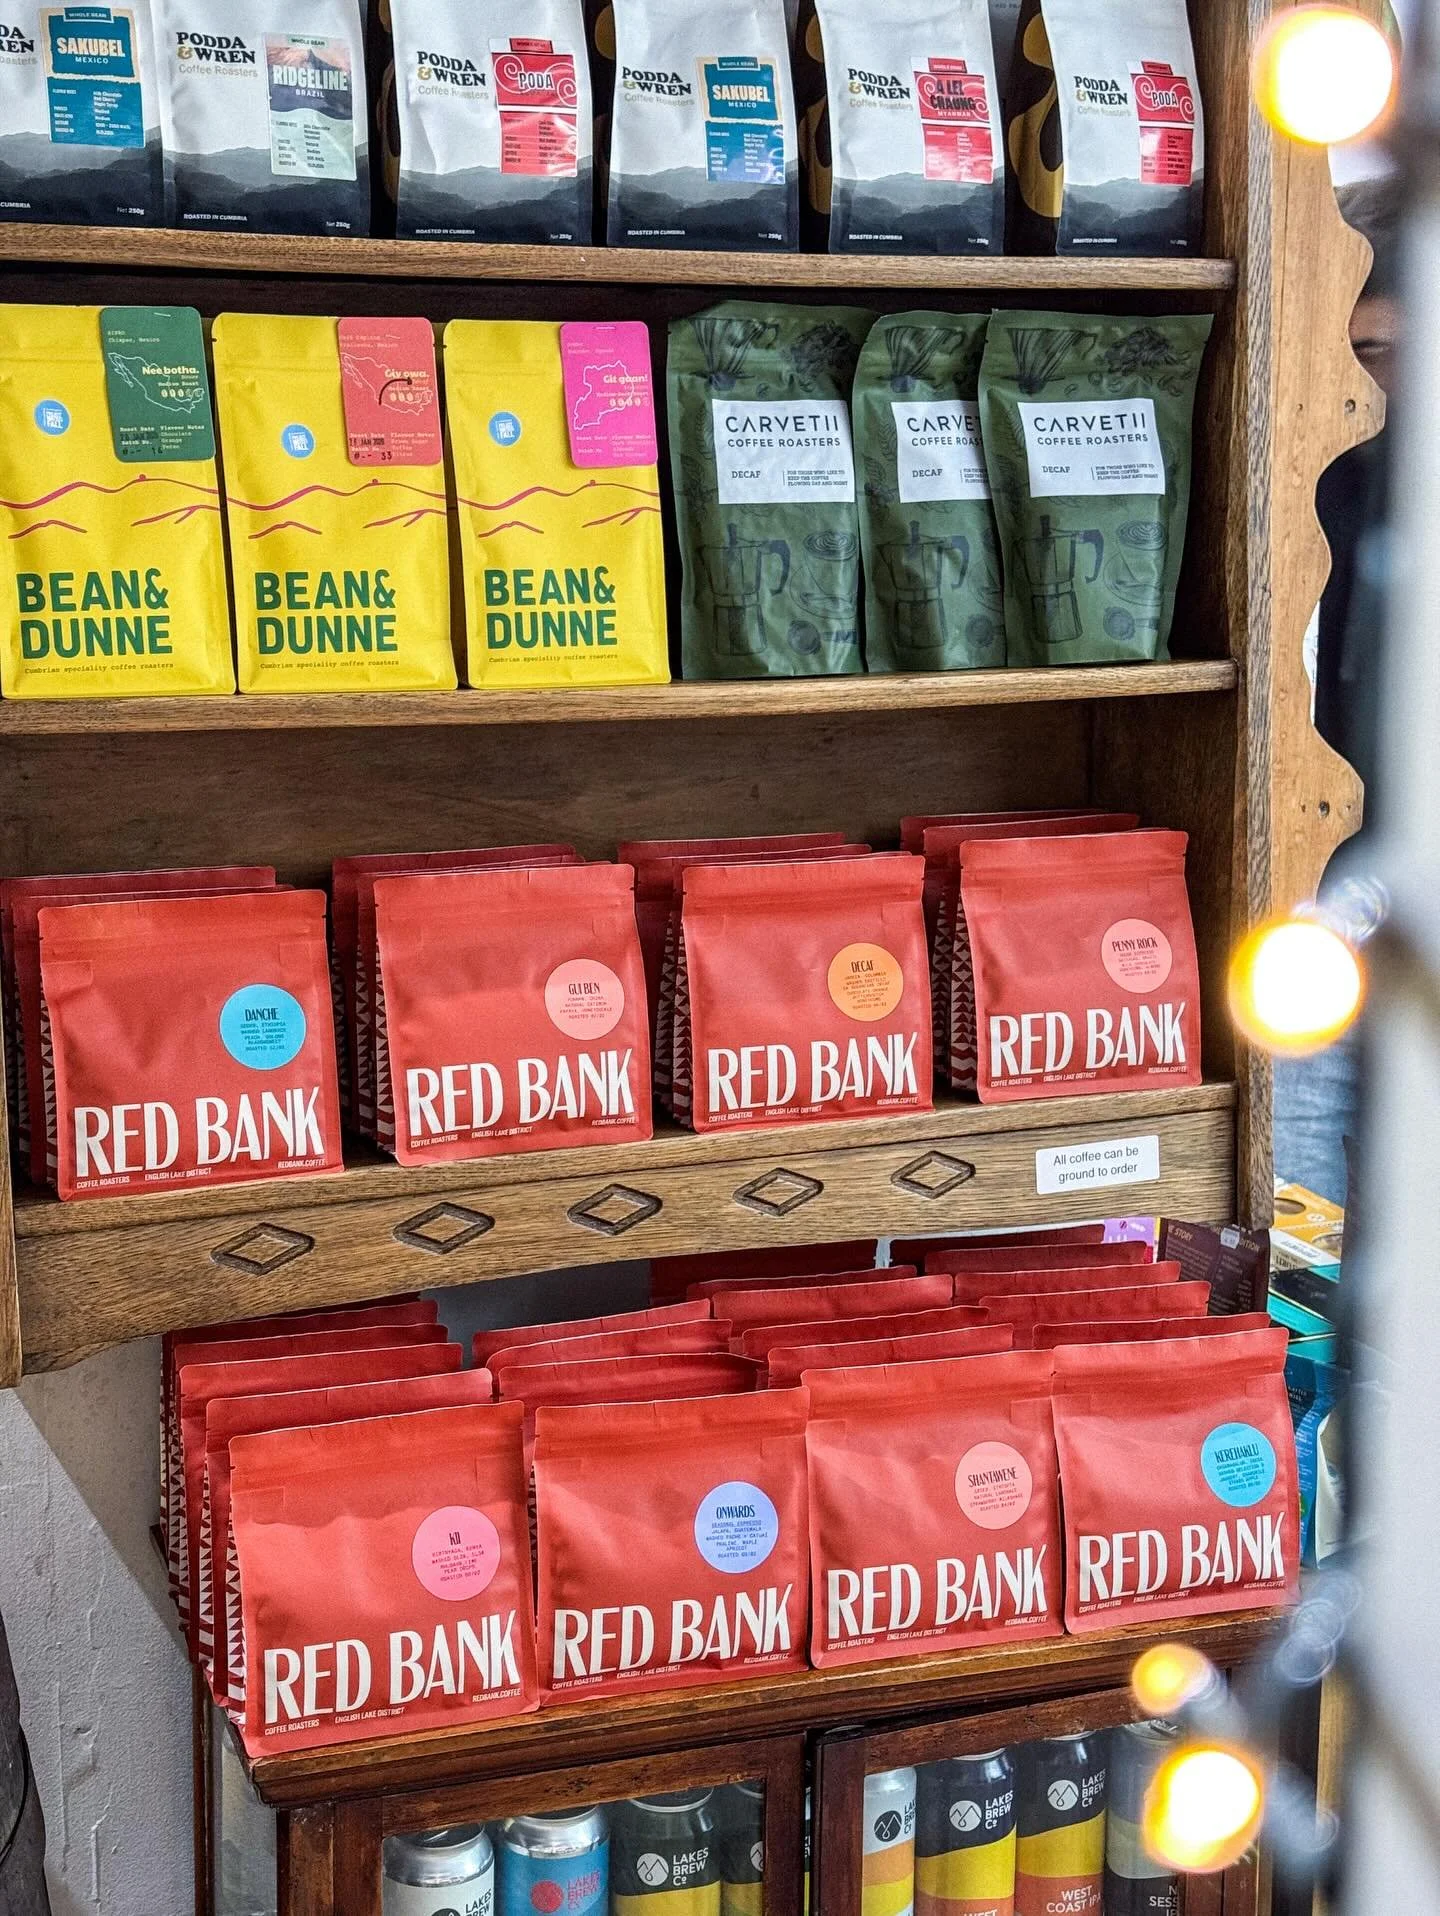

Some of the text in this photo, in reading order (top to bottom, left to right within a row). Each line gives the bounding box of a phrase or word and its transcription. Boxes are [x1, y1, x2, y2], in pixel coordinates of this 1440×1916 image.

[57, 37, 125, 57] SAKUBEL
[176, 31, 247, 50] PODDA
[75, 56, 108, 64] MEXICO
[417, 51, 477, 72] PODDA
[179, 64, 258, 78] Coffee Roasters
[272, 65, 348, 91] RIDGELINE
[622, 66, 683, 83] PODDA
[848, 68, 902, 87] PODDA
[519, 72, 555, 90] PODA
[937, 80, 945, 93] A
[1074, 76, 1120, 92] PODDA
[295, 89, 325, 98] BRAZIL
[418, 85, 449, 96] Coffee
[712, 85, 770, 102] SAKUBEL
[930, 95, 976, 111] CHAUNG
[1152, 91, 1179, 108] PODA
[938, 110, 971, 118] MYANMAR
[129, 207, 145, 216] 250g
[603, 375, 617, 383] Git
[725, 415, 839, 433] CARVETII
[1034, 413, 1145, 432] CARVETII
[728, 438, 840, 448] COFFEE ROASTERS
[912, 436, 953, 446] COFFEE
[1037, 434, 1148, 445] COFFEE ROASTERS
[732, 471, 761, 479] DECAF
[912, 469, 943, 478] DECAF
[16, 568, 168, 613] BEAN&
[255, 568, 396, 610] BEAN&
[484, 566, 615, 606] BEAN&
[20, 615, 173, 660] DUNNE
[257, 614, 398, 655] DUNNE
[486, 610, 618, 650] DUNNE
[24, 662, 174, 675] Cumbrian speciality coffee roasters
[296, 662, 337, 670] speciality
[523, 656, 561, 664] speciality
[1112, 937, 1158, 952] PENNY ROCK
[851, 960, 874, 973] DECAF
[569, 982, 600, 995] GUI BEN
[245, 1008, 280, 1021] DANCHE
[990, 1002, 1186, 1077] RED BANK
[708, 1032, 918, 1113] RED BANK
[406, 1048, 635, 1137] RED BANK
[74, 1086, 325, 1177] RED BANK
[411, 1126, 533, 1148] COFFEE ROASTERS ENGLISH LAKE DISTRICT
[1053, 1146, 1139, 1166] All coffee can be
[76, 1168, 212, 1189] COFFEE ROASTERS ENGLISH LAKE DISTRICT
[1058, 1162, 1138, 1184] ground to order
[968, 1466, 1019, 1488] SHANTAWENE
[716, 1505, 755, 1519] ONWARDS
[1079, 1512, 1285, 1602] RED BANK
[827, 1544, 1048, 1639] RED BANK
[553, 1583, 793, 1680] RED BANK
[827, 1627, 947, 1650] COFFEE ROASTERS ENGLISH LAKE DISTRICT
[264, 1610, 521, 1724] RED BANK
[265, 1706, 405, 1736] COFFEE ROASTERS ENGLISH LAKE DISTRICT
[1082, 1769, 1106, 1788] LAKES
[1082, 1781, 1104, 1798] BREW
[986, 1790, 1013, 1808] LAKES
[986, 1803, 1012, 1820] BREW
[673, 1848, 709, 1865] LAKES
[673, 1859, 706, 1876] BREW
[465, 1889, 492, 1913] LAKES
[1062, 1886, 1093, 1901] WEST
[1047, 1901, 1087, 1913] COAST
